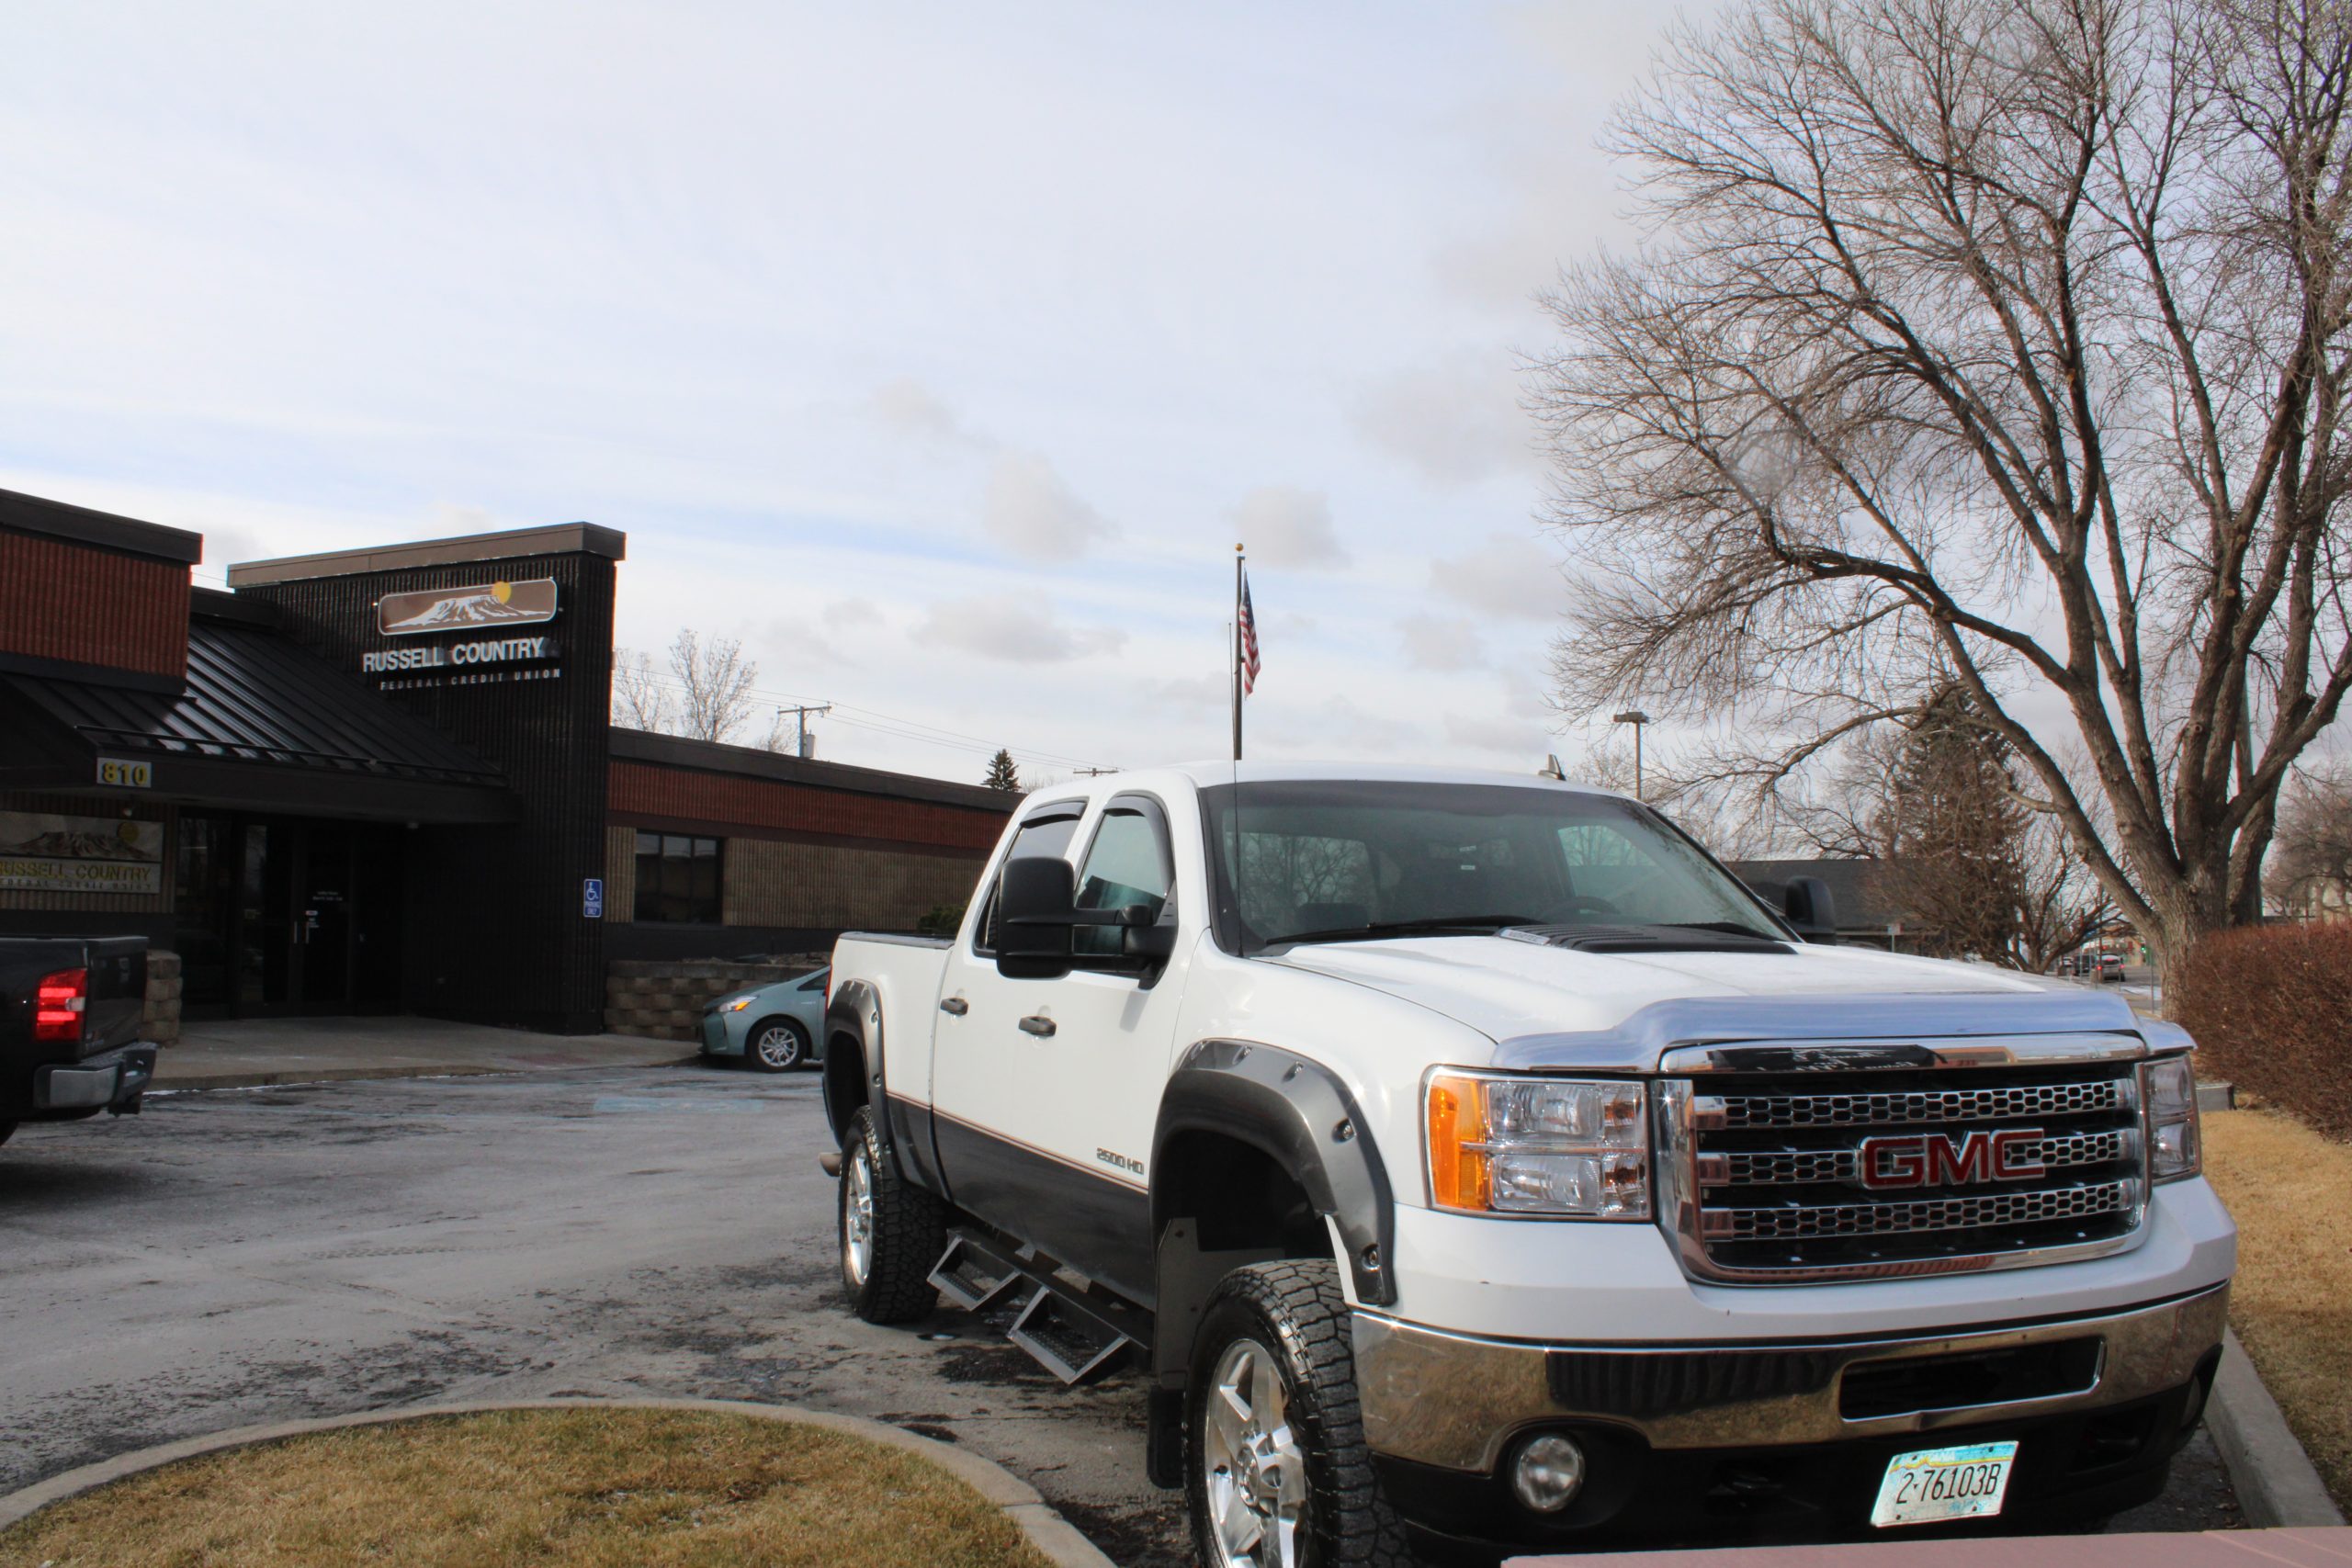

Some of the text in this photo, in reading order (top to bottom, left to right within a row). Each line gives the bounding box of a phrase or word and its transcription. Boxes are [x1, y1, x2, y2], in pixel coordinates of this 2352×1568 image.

[363, 637, 545, 672] RUSSELL COUNTRY
[380, 668, 561, 691] FEDERAL CREDIT UNION
[102, 761, 148, 785] 810
[75, 864, 152, 881] COUNTRY
[1097, 1147, 1144, 1175] 2500 HD
[1859, 1127, 2045, 1190] GMC
